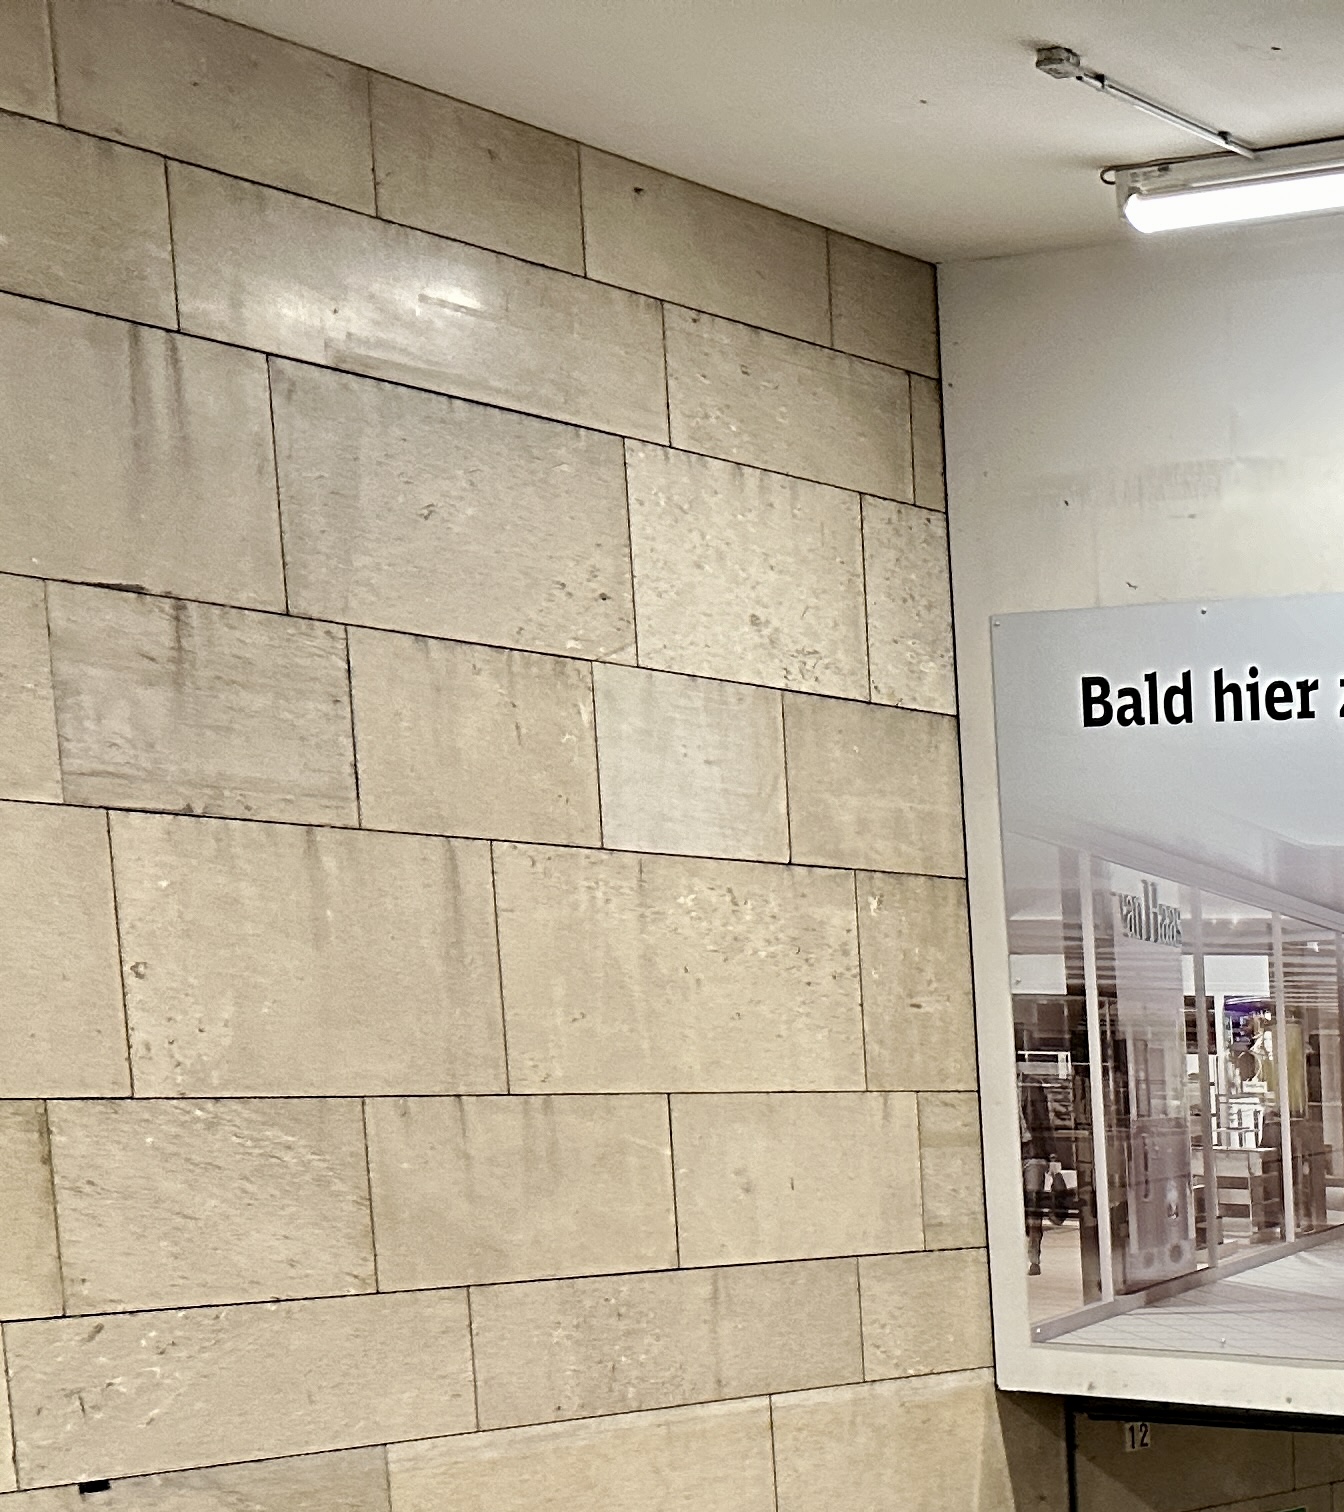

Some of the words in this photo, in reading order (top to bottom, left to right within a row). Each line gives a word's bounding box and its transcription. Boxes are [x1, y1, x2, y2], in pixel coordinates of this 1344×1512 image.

[1081, 669, 1194, 728] Bald
[1212, 665, 1319, 723] hier
[1128, 1423, 1150, 1449] 12
